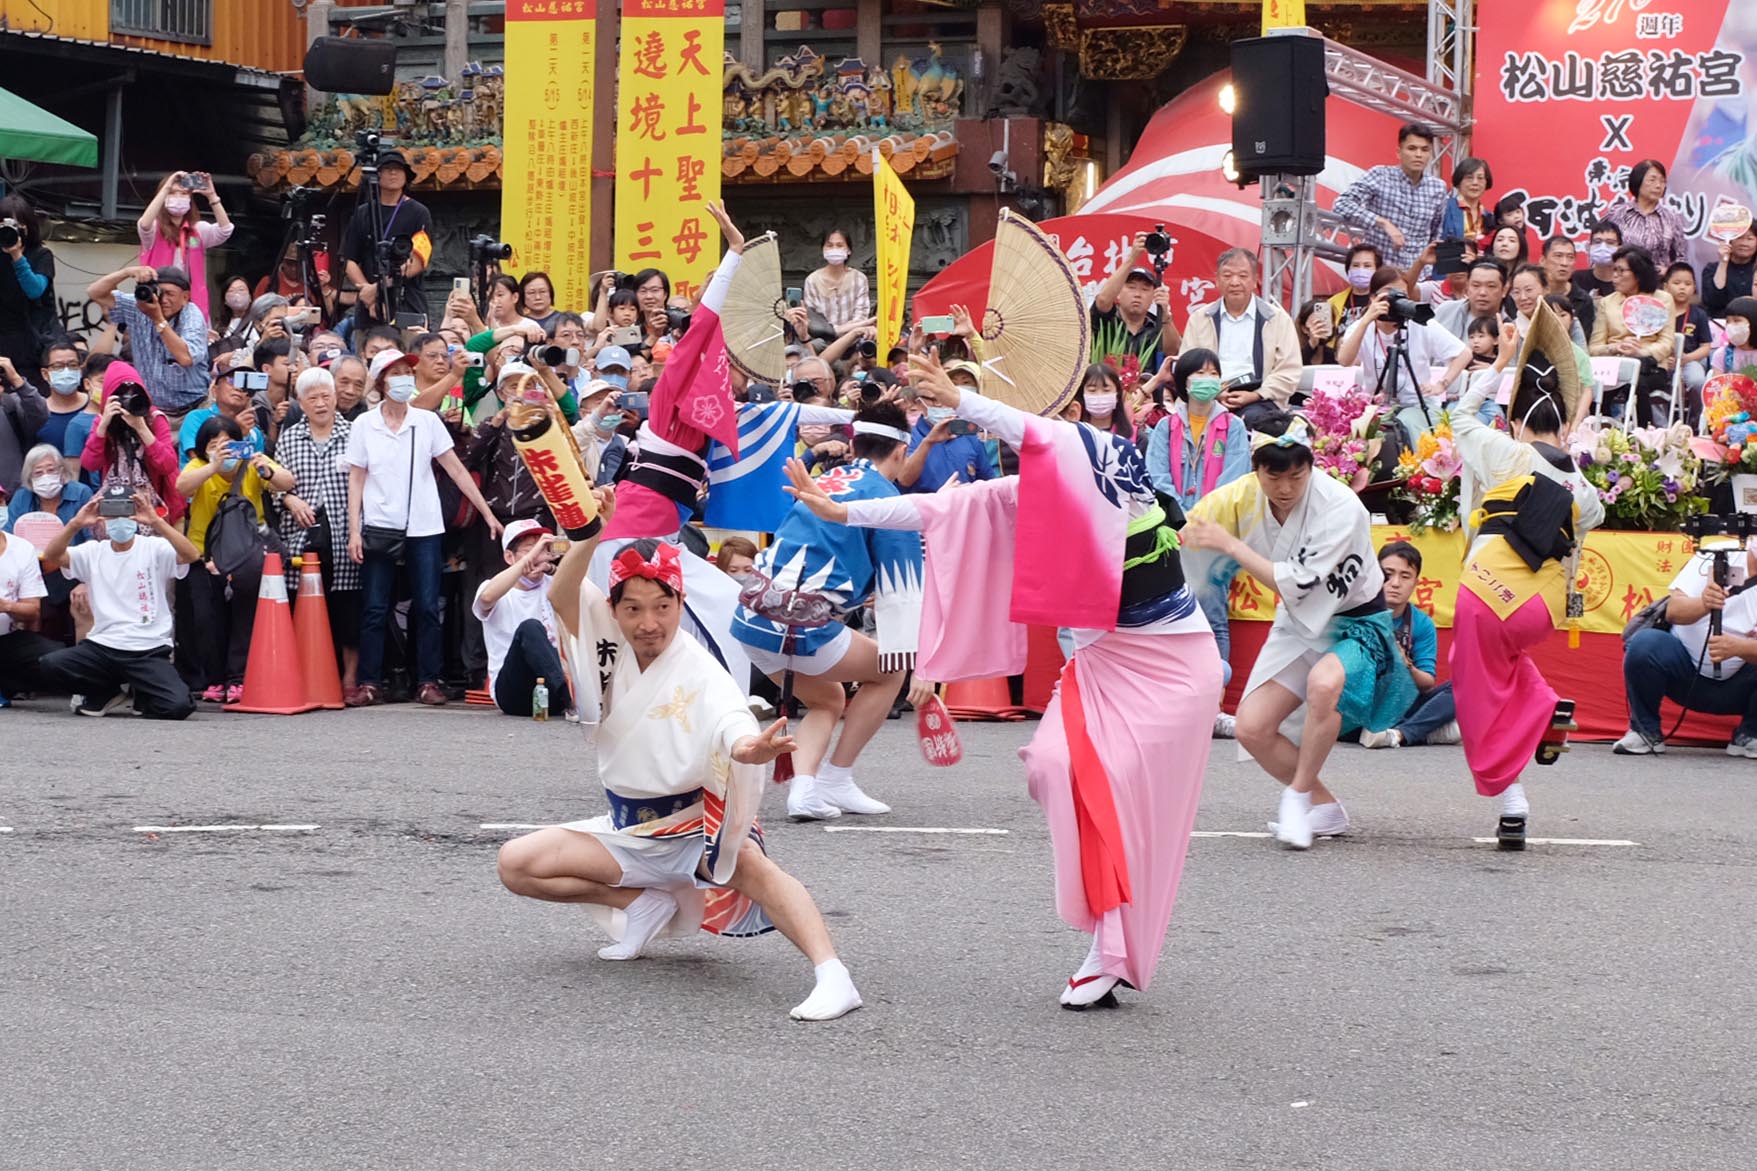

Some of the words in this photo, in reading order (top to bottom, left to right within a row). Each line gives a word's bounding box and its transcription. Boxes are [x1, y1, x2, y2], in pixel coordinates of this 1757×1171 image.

[1638, 14, 1682, 36] 週年
[1502, 52, 1742, 99] 松山慈祐宮
[1602, 117, 1630, 149] X
